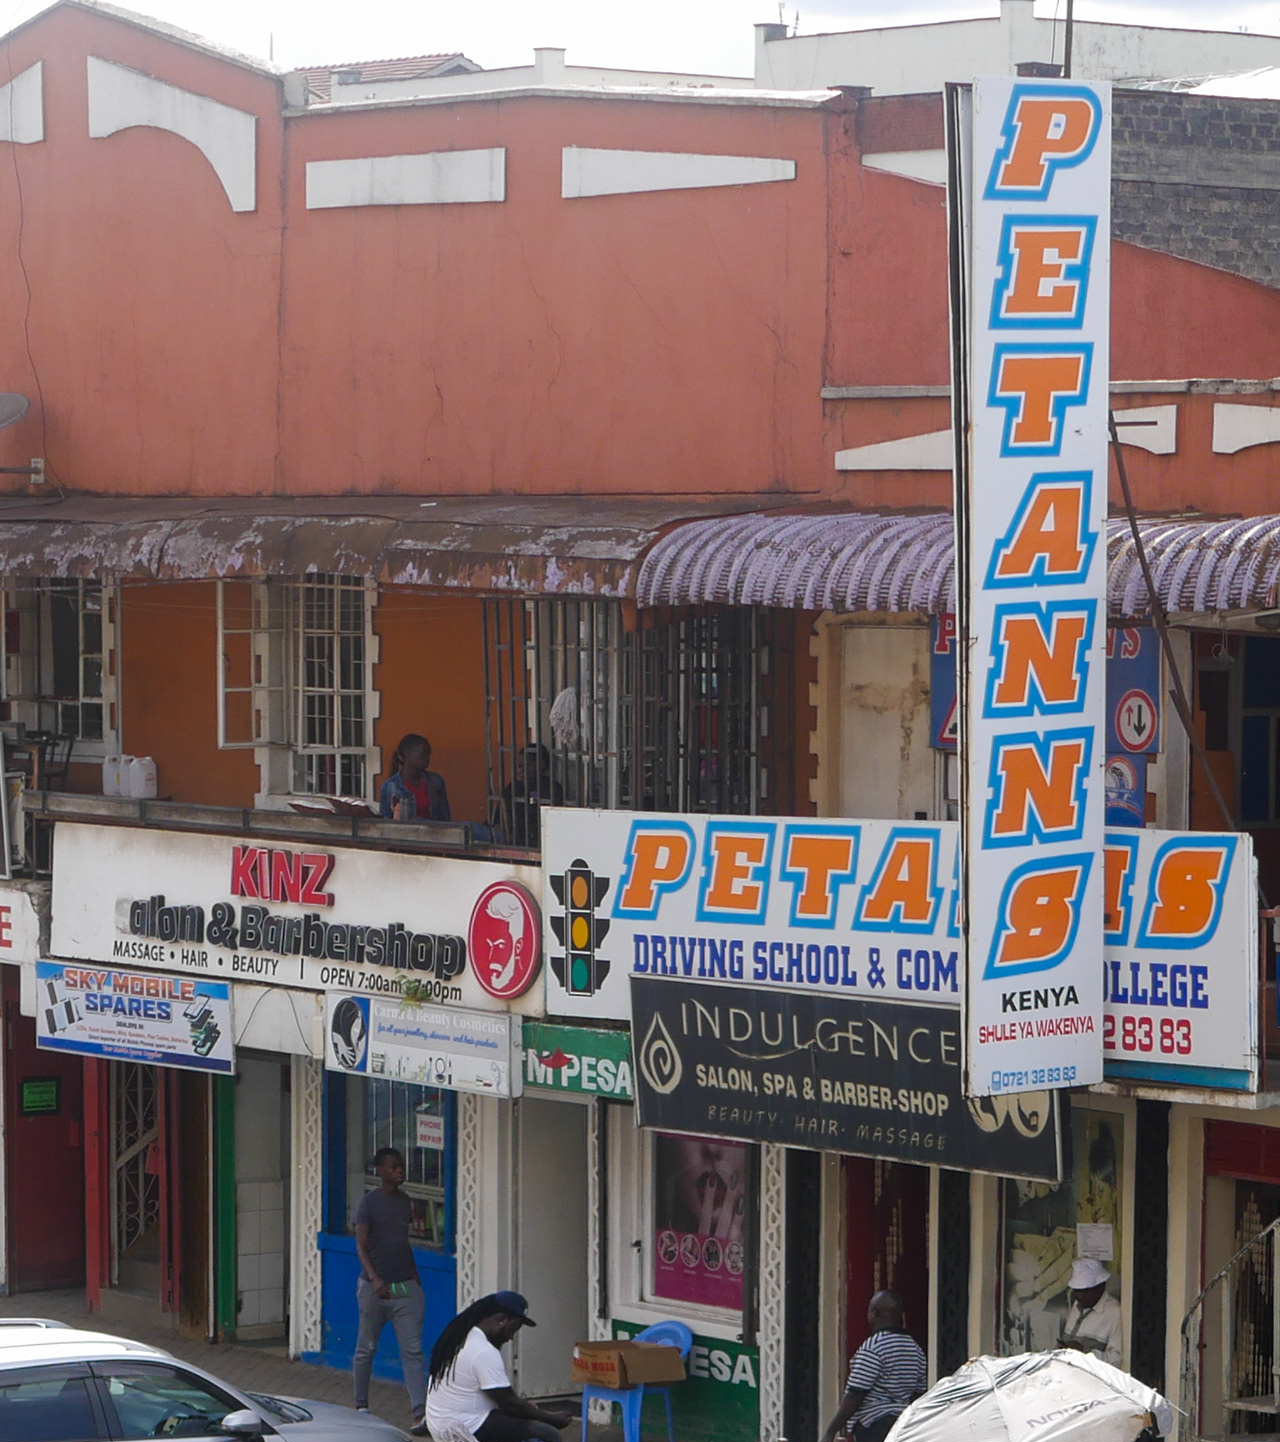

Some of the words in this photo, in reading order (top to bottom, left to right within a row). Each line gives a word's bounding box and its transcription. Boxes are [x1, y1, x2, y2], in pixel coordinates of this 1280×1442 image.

[231, 846, 335, 907] KINZ
[206, 902, 238, 950] &
[239, 905, 467, 982] Barbershop
[113, 940, 165, 962] MASSAGE
[181, 949, 208, 968] HAIR
[232, 955, 278, 976] BEAUTY
[320, 967, 355, 988] OPEN
[633, 934, 744, 980] DRIVING
[752, 941, 858, 987] SCHOOL
[867, 950, 887, 989] &
[64, 968, 108, 991] SKY
[111, 973, 195, 1003] MOBILE
[1001, 985, 1080, 1013] KENYA
[85, 993, 173, 1023] SPARES
[417, 1009, 451, 1029] Beauty
[452, 1014, 506, 1036] Cosmetics
[680, 998, 958, 1067] INDULGENCE
[978, 1022, 1017, 1044] SHULE
[1018, 1020, 1034, 1039] YA
[1035, 1015, 1095, 1038] WAKENYA
[1122, 1016, 1154, 1052] 83
[1160, 1018, 1192, 1055] 83
[696, 1064, 758, 1097] SALON,
[763, 1074, 797, 1099] SPA
[802, 1077, 815, 1100] &
[821, 1079, 950, 1117] BARBER-SHOP
[1001, 1070, 1030, 1087] 0721
[1031, 1068, 1045, 1085] 32
[1046, 1067, 1061, 1082] 83
[1062, 1065, 1077, 1081] 83
[420, 1119, 441, 1130] PHONE
[420, 1134, 442, 1145] REPAIR
[708, 1105, 777, 1130] BEAUTY
[795, 1117, 839, 1136] HAIR
[856, 1124, 947, 1150] MASSAGE
